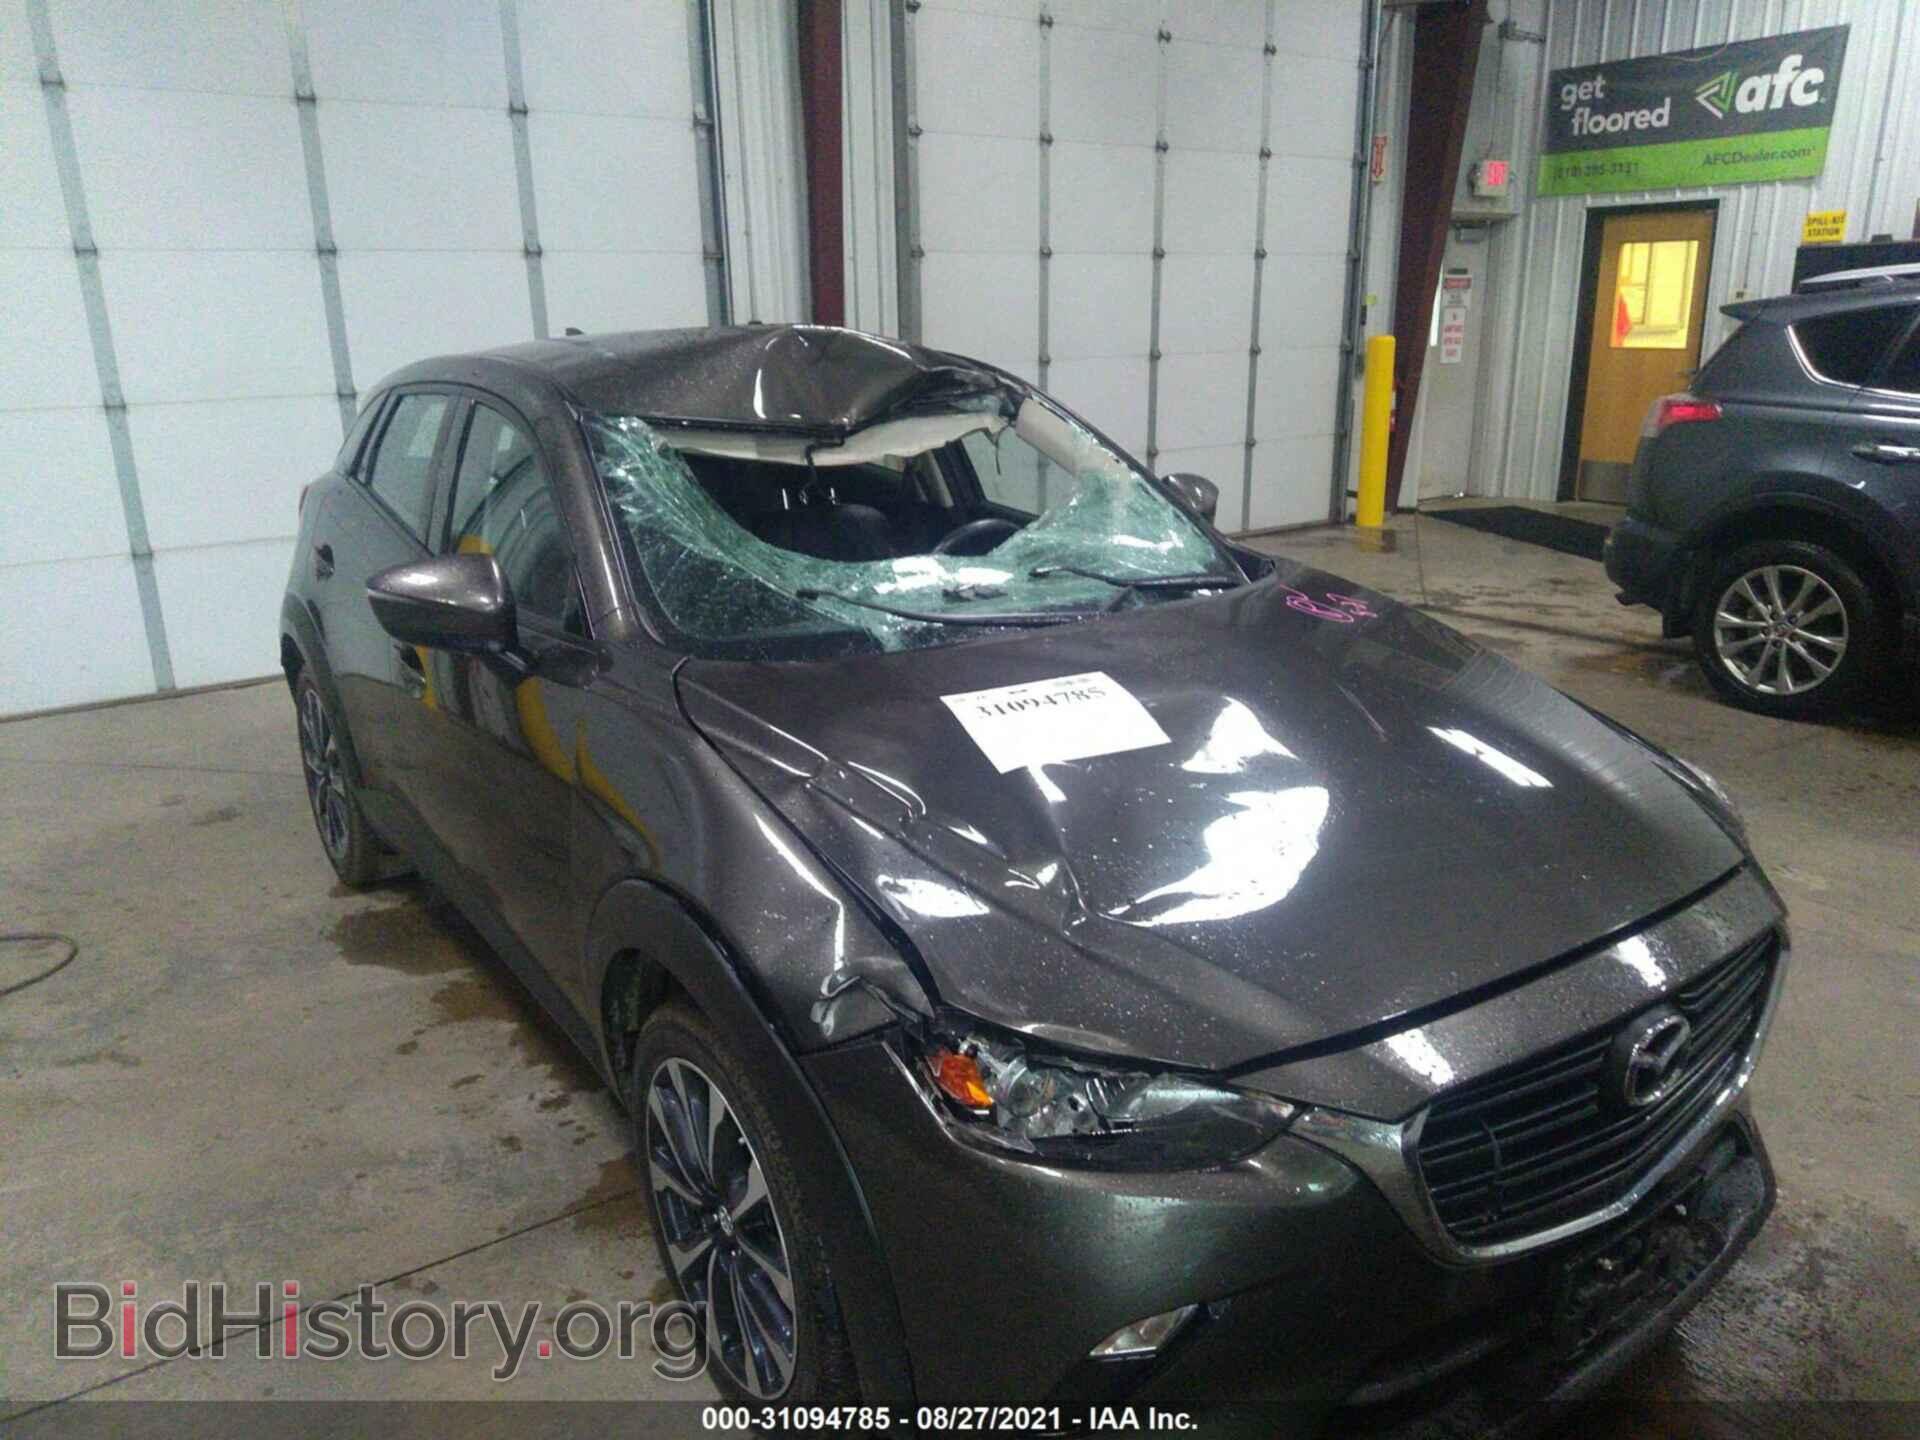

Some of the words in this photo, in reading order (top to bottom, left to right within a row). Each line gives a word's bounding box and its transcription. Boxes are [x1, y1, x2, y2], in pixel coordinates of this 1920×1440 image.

[1561, 74, 1606, 110] get
[1735, 54, 1825, 114] afc
[1571, 97, 1671, 137] floored
[975, 686, 1107, 718] 31094785
